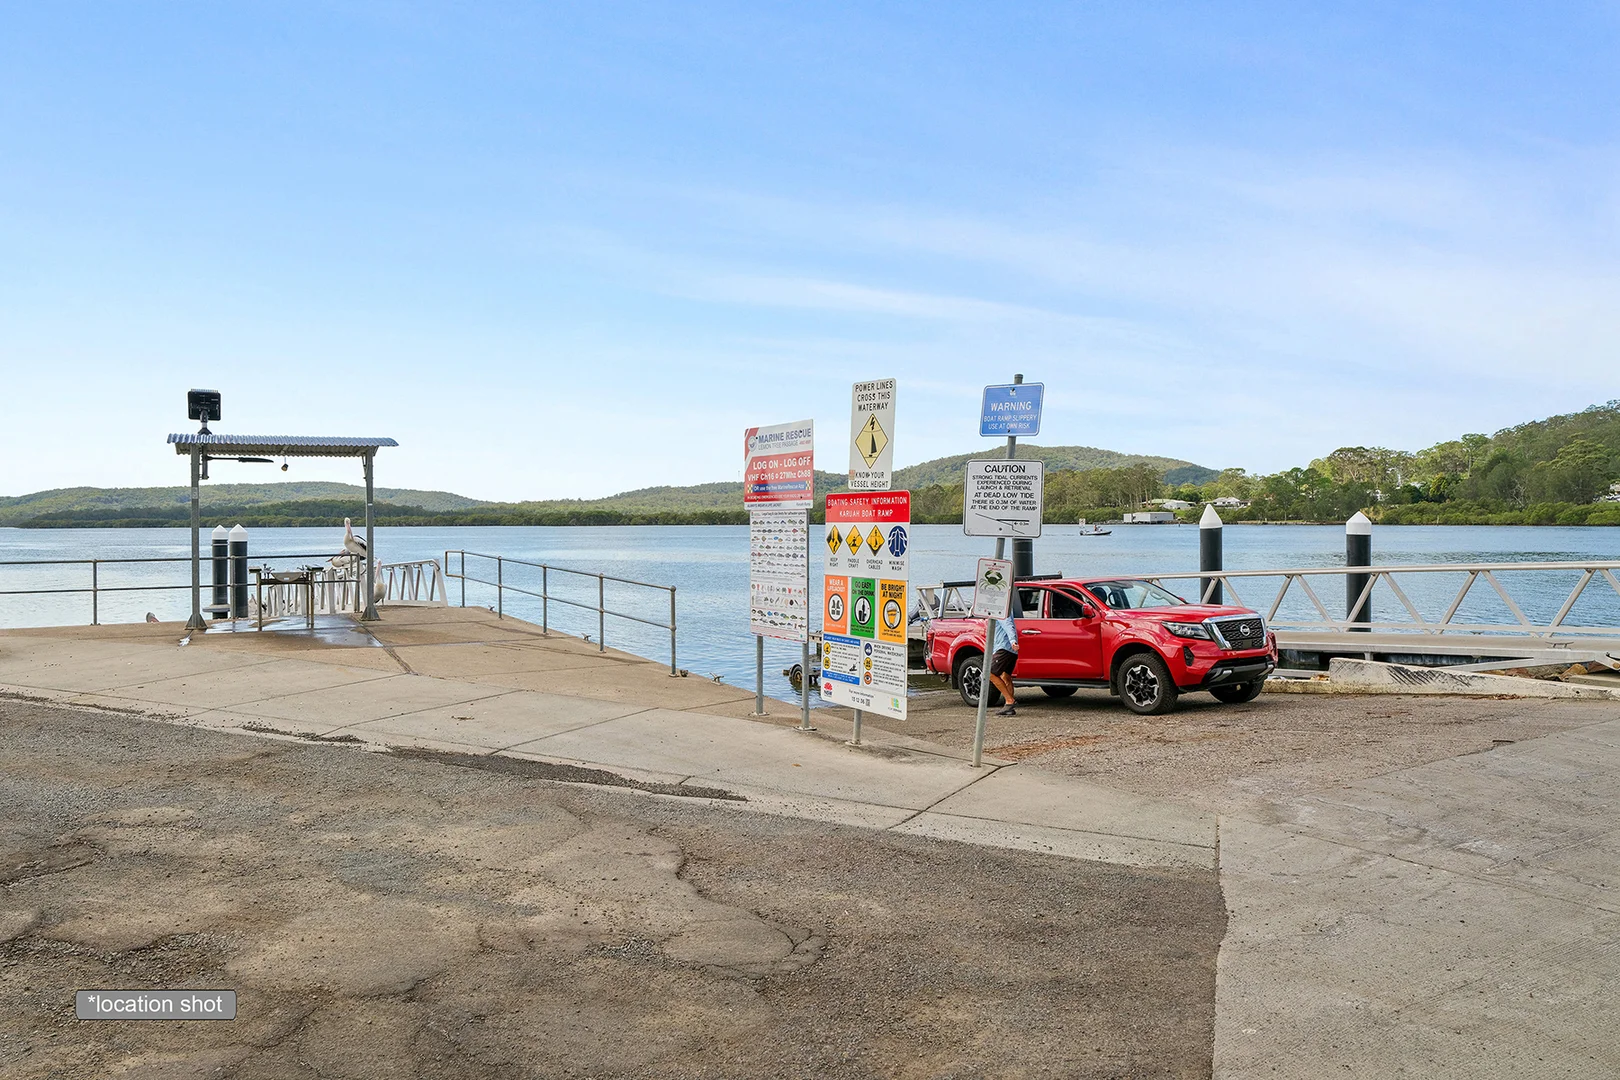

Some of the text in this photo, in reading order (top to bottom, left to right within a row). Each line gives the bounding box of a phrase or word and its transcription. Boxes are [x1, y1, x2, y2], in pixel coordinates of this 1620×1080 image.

[855, 381, 893, 392] POWER LINES
[857, 392, 890, 402] CROSS THIS
[858, 402, 888, 412] WATERWAY
[991, 401, 1032, 411] WARNING
[758, 428, 811, 443] MARINE RESCUE
[753, 461, 767, 470] LOG
[768, 460, 778, 468] ON
[784, 458, 796, 468] LOG
[798, 456, 810, 466] OFF
[984, 465, 1025, 473] CAUTION
[871, 497, 907, 505] INFORMATION
[888, 584, 904, 592] BRIGHT
